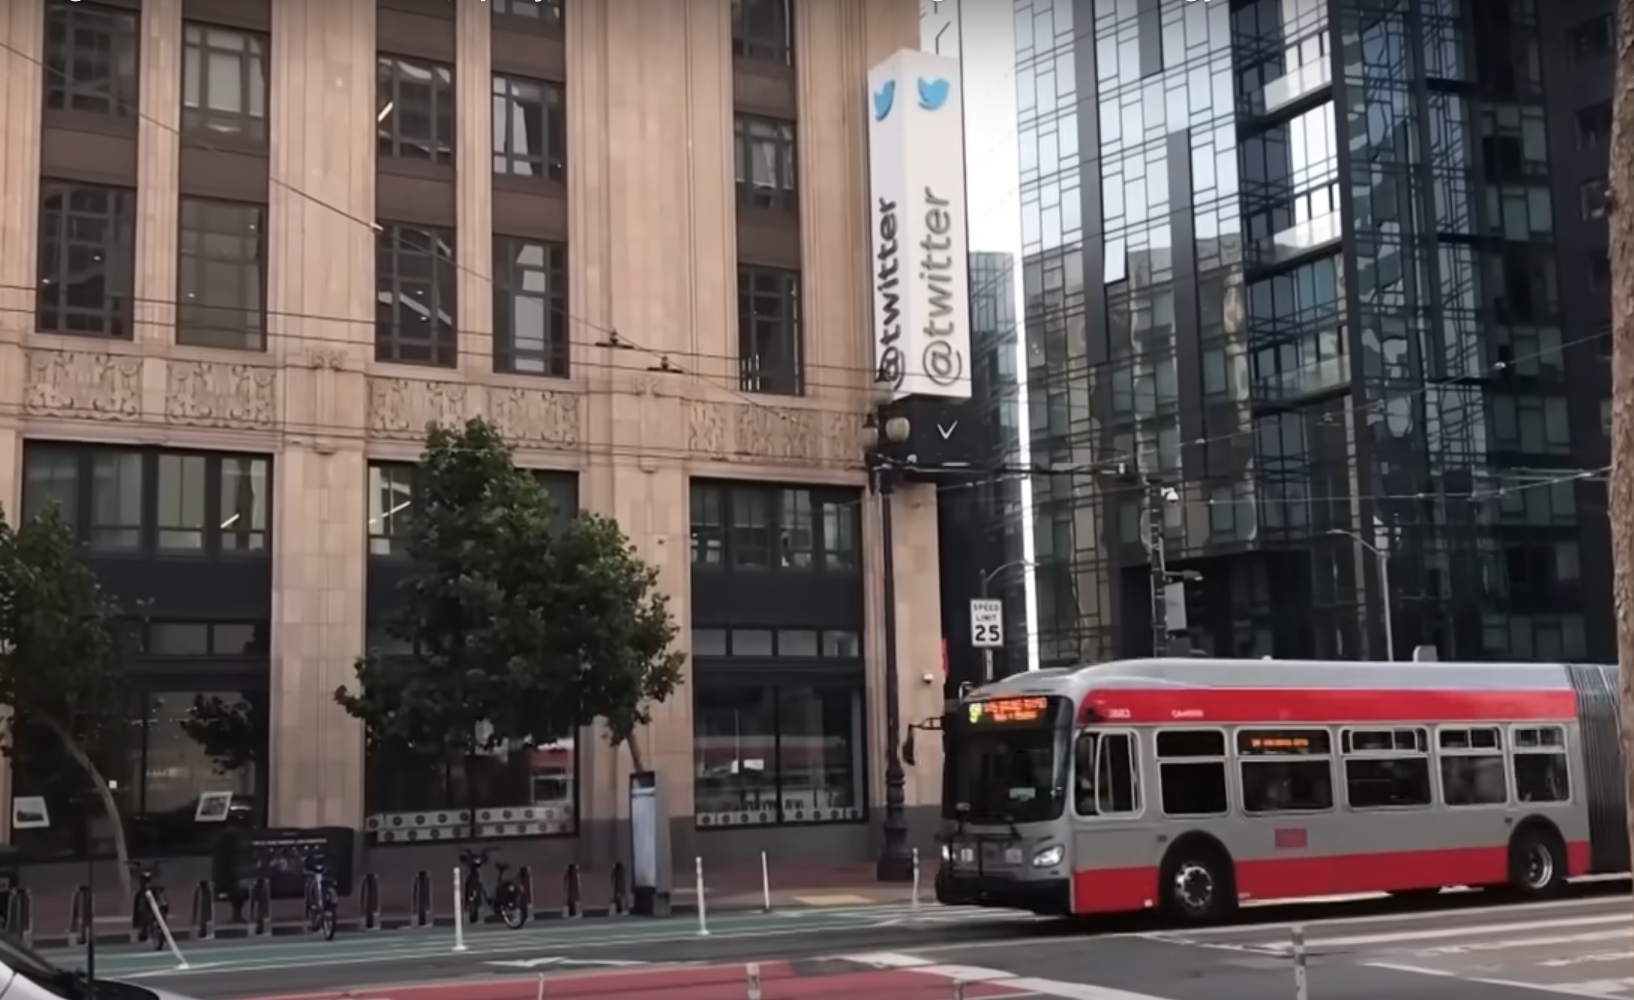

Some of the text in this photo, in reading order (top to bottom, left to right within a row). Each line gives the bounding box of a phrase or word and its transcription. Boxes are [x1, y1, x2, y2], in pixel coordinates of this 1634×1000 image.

[877, 197, 905, 391] @twitter
[919, 186, 962, 386] @twitter
[973, 603, 1000, 612] SPEED
[975, 614, 997, 622] LIMIT
[975, 624, 1000, 642] 25
